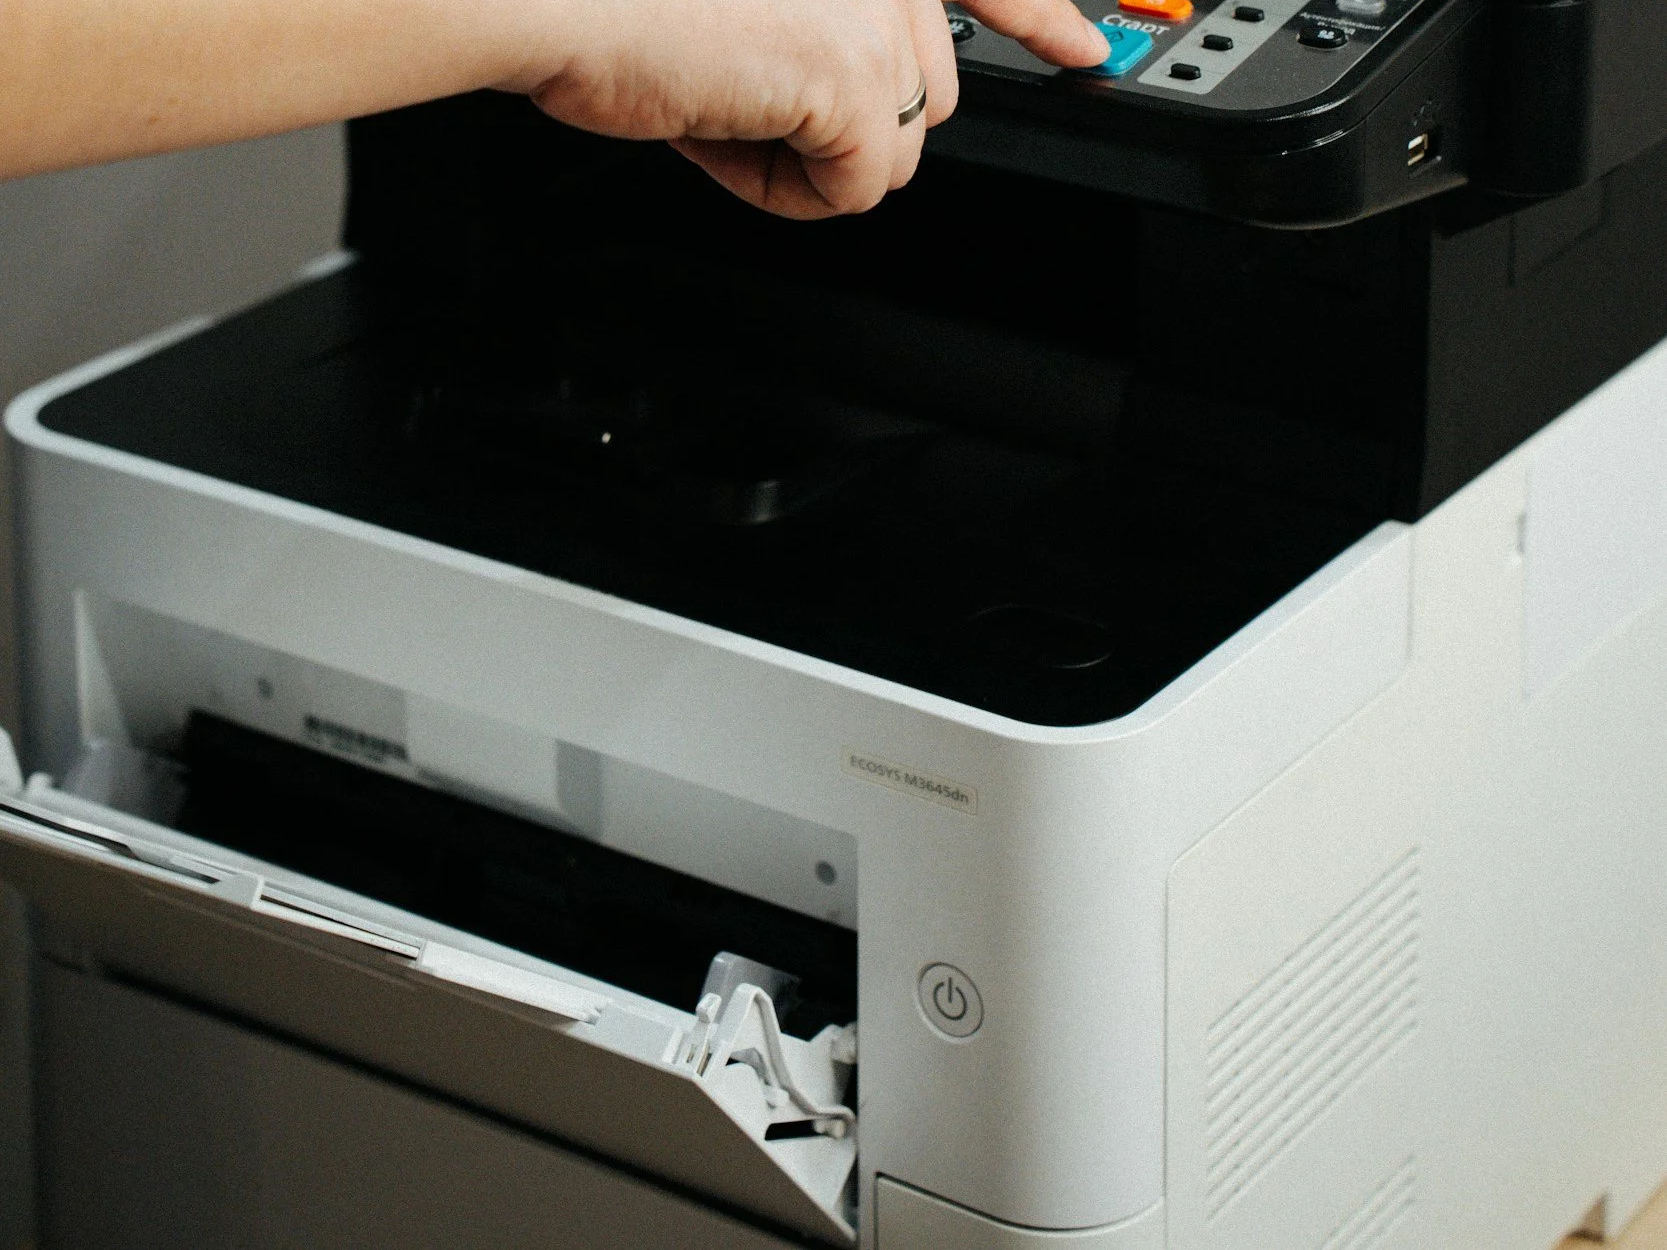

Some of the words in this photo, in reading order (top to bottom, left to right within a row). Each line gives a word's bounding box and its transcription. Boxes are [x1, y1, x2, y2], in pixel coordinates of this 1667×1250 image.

[1102, 14, 1170, 35] Старт
[850, 755, 901, 781] ECOSYS
[904, 772, 969, 804] M3645dn
